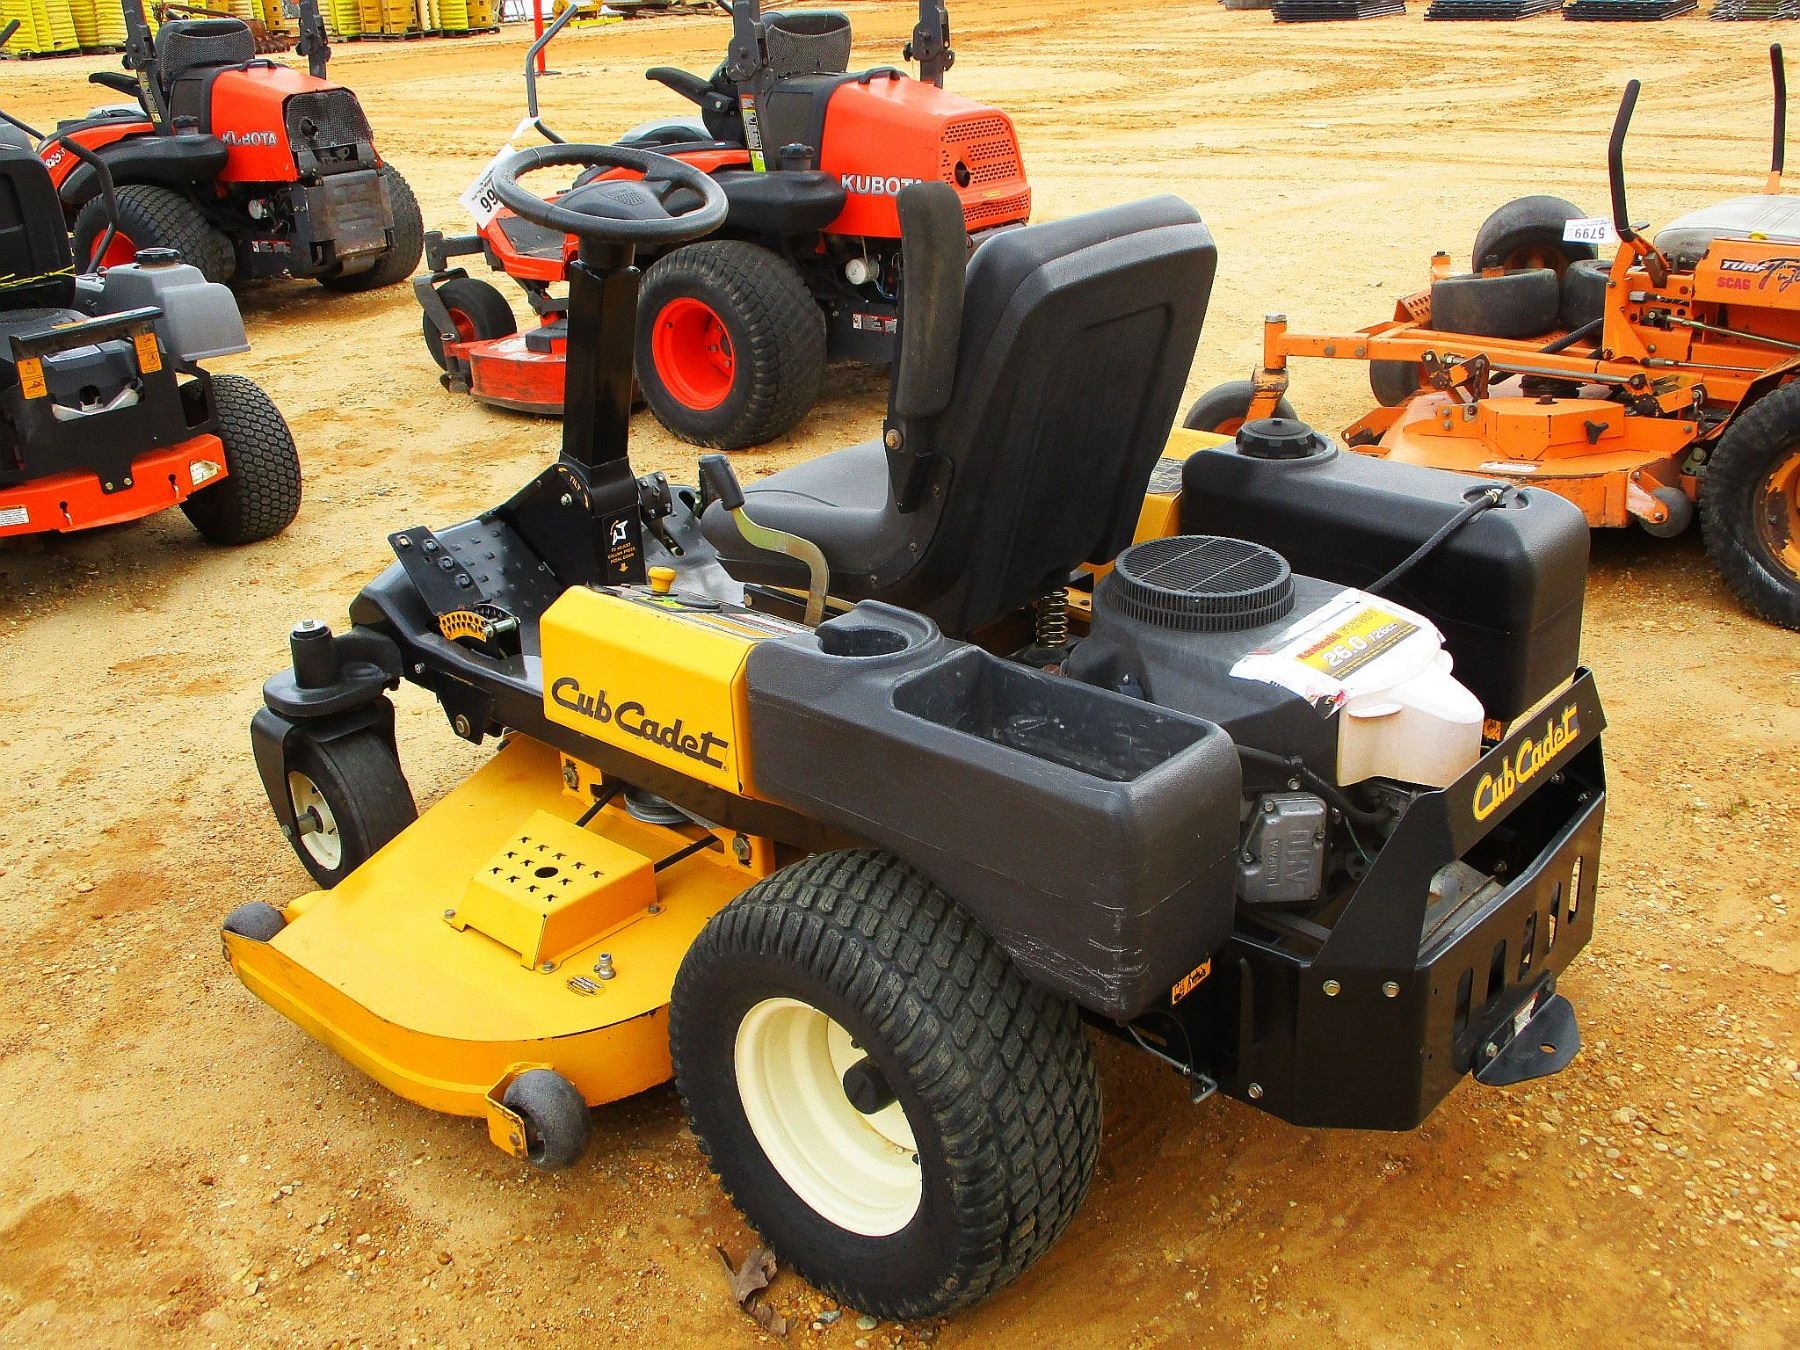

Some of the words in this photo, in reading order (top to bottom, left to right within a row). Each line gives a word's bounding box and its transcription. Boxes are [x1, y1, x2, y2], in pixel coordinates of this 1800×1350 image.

[841, 174, 923, 196] KUBOT
[1575, 227, 1605, 239] 5799
[1721, 260, 1766, 273] TURF
[1717, 276, 1751, 291] SCAG
[569, 474, 582, 491] TILT
[1321, 635, 1370, 667] 26.0
[551, 676, 613, 724] Cub
[614, 701, 729, 770] Cadet
[1473, 755, 1516, 821] Cub
[1515, 702, 1580, 784] Cadet
